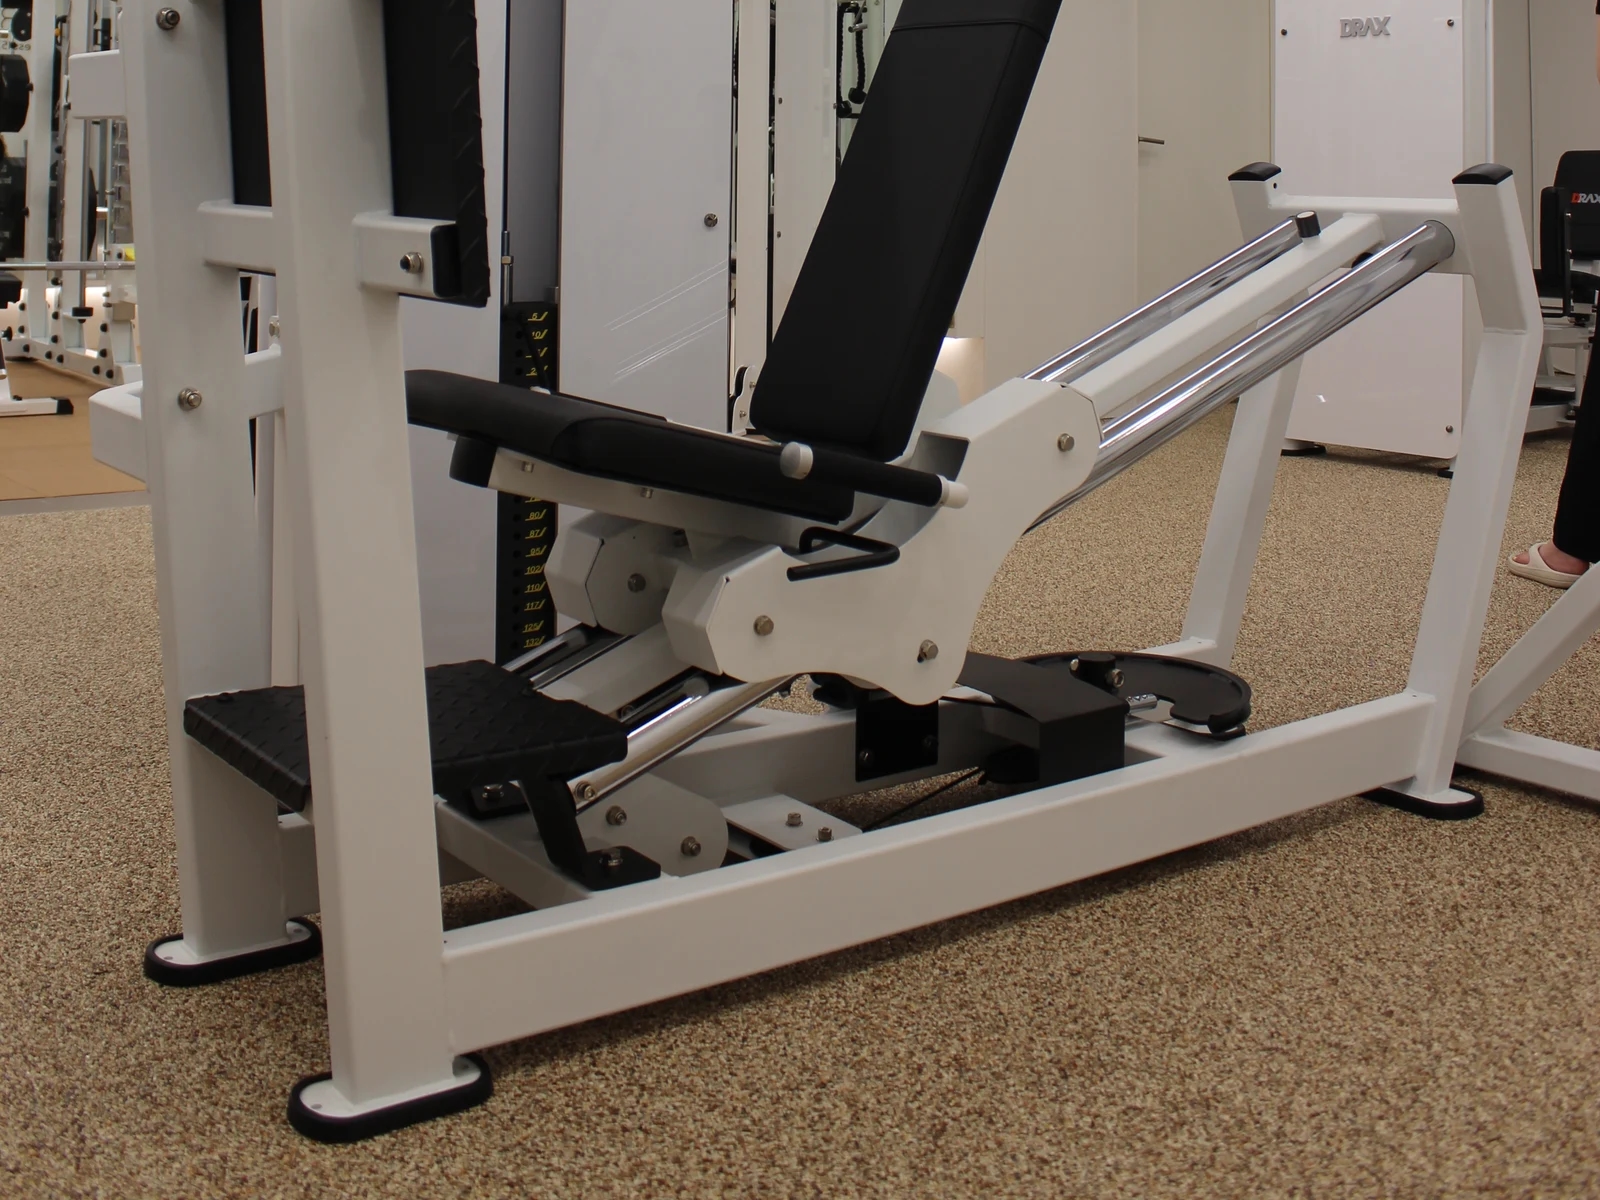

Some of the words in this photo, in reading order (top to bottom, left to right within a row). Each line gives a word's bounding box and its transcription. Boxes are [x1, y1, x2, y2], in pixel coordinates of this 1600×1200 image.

[1340, 15, 1391, 38] DRAX
[529, 511, 541, 520] 80
[529, 529, 541, 538] 87
[530, 547, 542, 556] 95
[526, 565, 541, 574] 102
[526, 583, 541, 592] 110
[525, 601, 540, 610] 117
[524, 623, 540, 632] 125
[525, 637, 541, 647] 132
